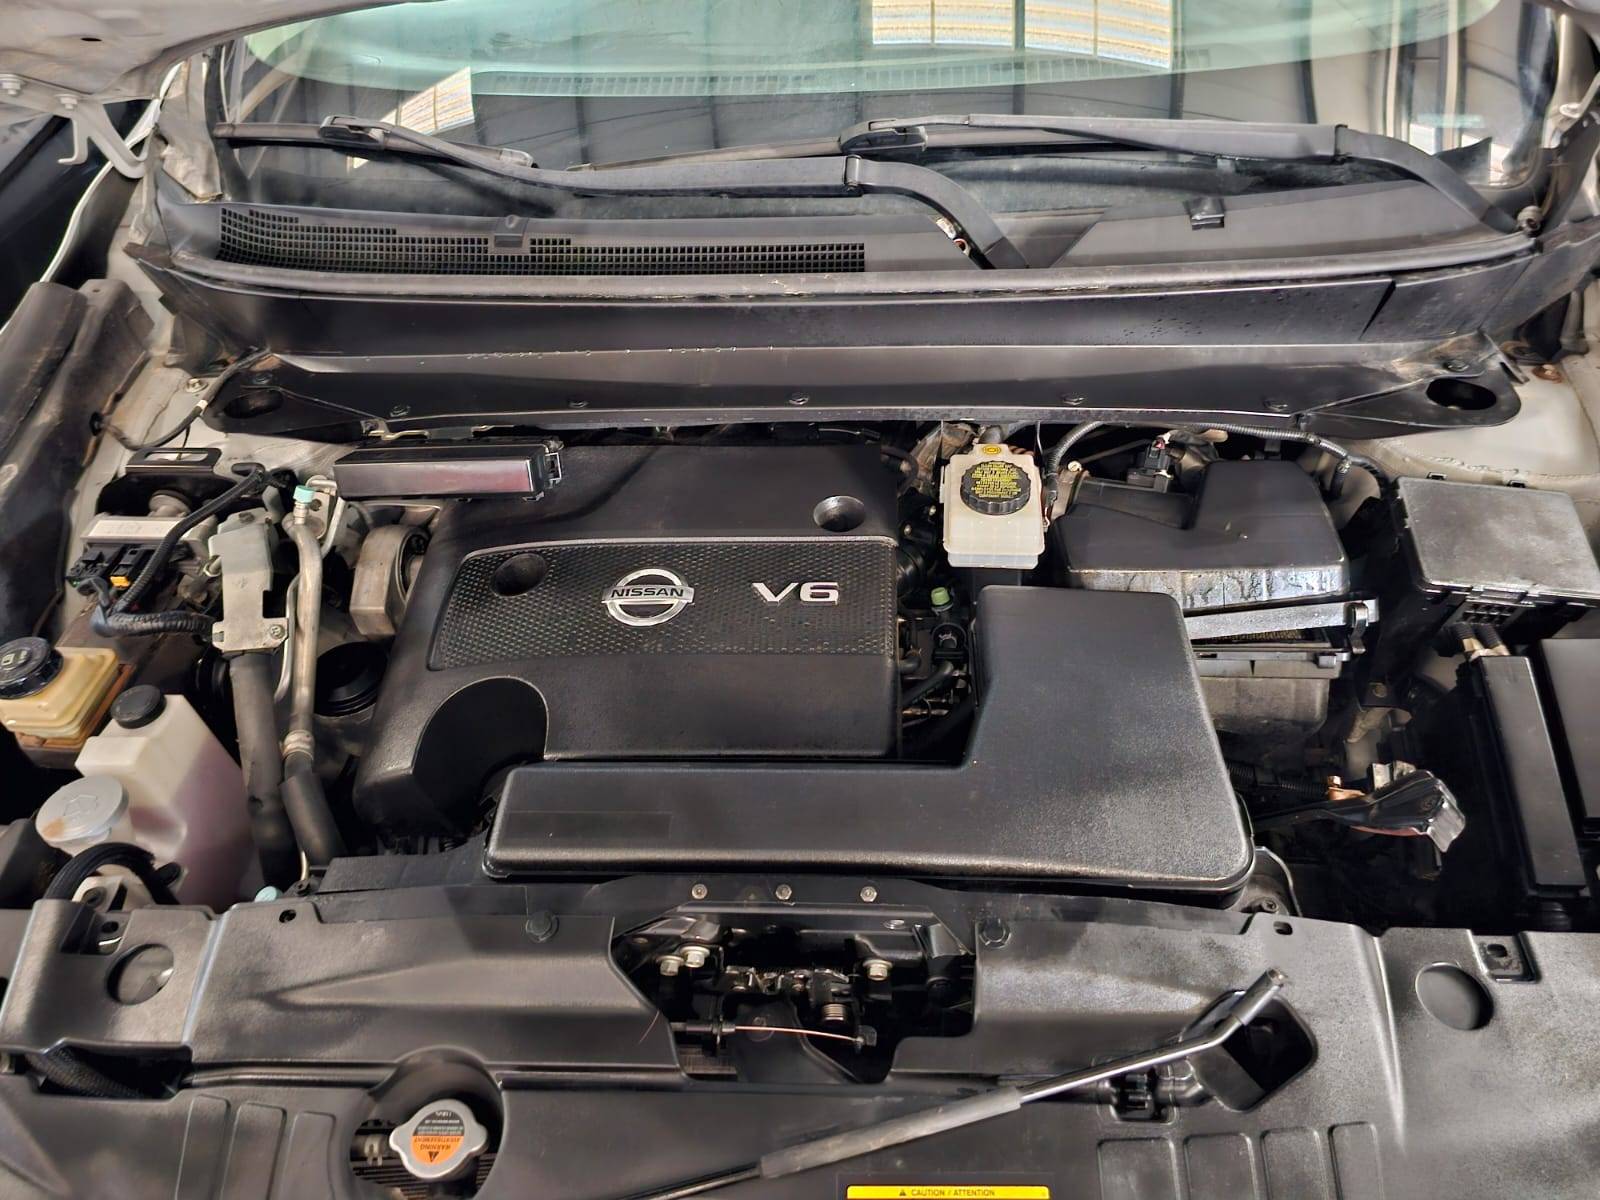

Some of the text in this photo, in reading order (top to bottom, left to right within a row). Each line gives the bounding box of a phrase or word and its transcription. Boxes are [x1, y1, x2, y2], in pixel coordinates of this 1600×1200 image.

[610, 587, 685, 598] NISSAN
[752, 581, 839, 606] V6
[911, 1189, 945, 1197] CAUTION
[953, 1189, 996, 1197] ATTENTION
